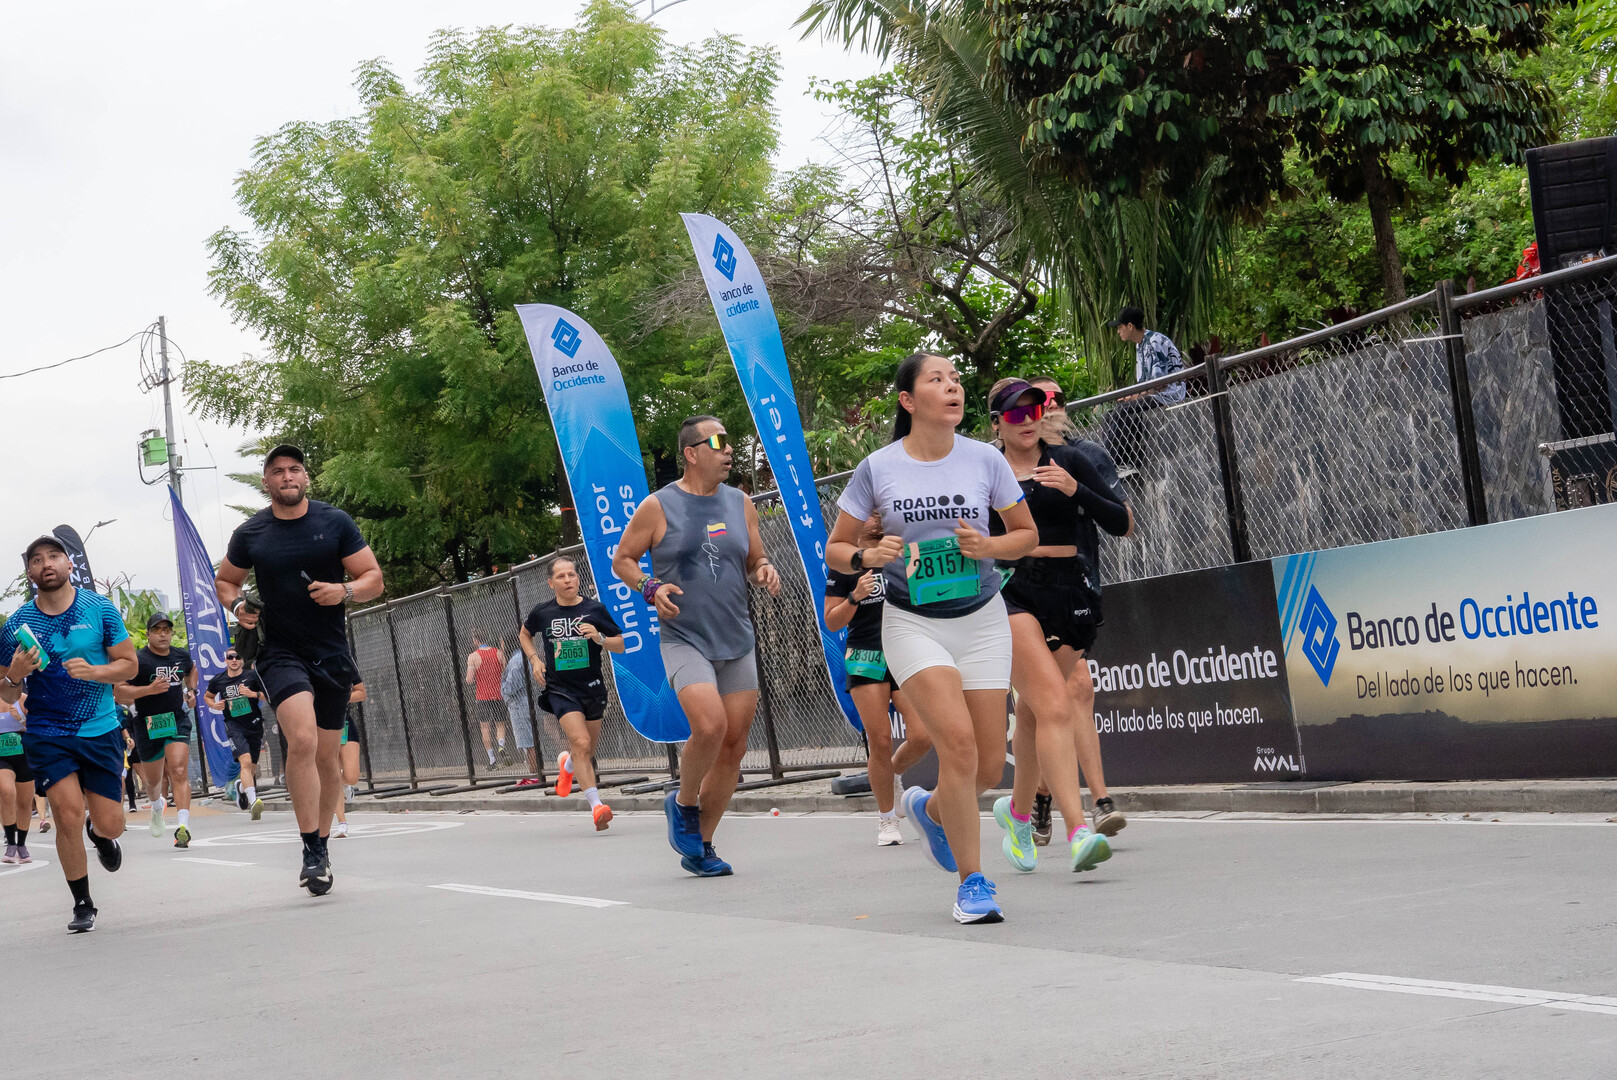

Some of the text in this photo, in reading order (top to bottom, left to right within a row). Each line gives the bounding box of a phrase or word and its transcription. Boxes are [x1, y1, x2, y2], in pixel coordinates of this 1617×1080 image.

[719, 282, 754, 302] anco de
[726, 299, 760, 318] ccidente
[552, 360, 600, 378] Banco de
[553, 374, 606, 392] Occidente
[893, 496, 937, 512] ROAD
[903, 507, 980, 524] RUNNERS
[592, 483, 644, 655] Unids por
[913, 551, 966, 580] 28157
[551, 616, 584, 638] 5K
[1346, 591, 1599, 651] Banco de Occidente
[558, 647, 583, 660] 25063
[848, 649, 881, 664] 28304
[1086, 645, 1278, 693] Banco de Occidente
[1356, 660, 1578, 699] Del lado de los que hacen.
[149, 718, 171, 731] 28337
[1094, 701, 1264, 734] Del lado de los que hacen.
[1256, 746, 1275, 755] Grupo
[1253, 754, 1300, 772] AVAL
